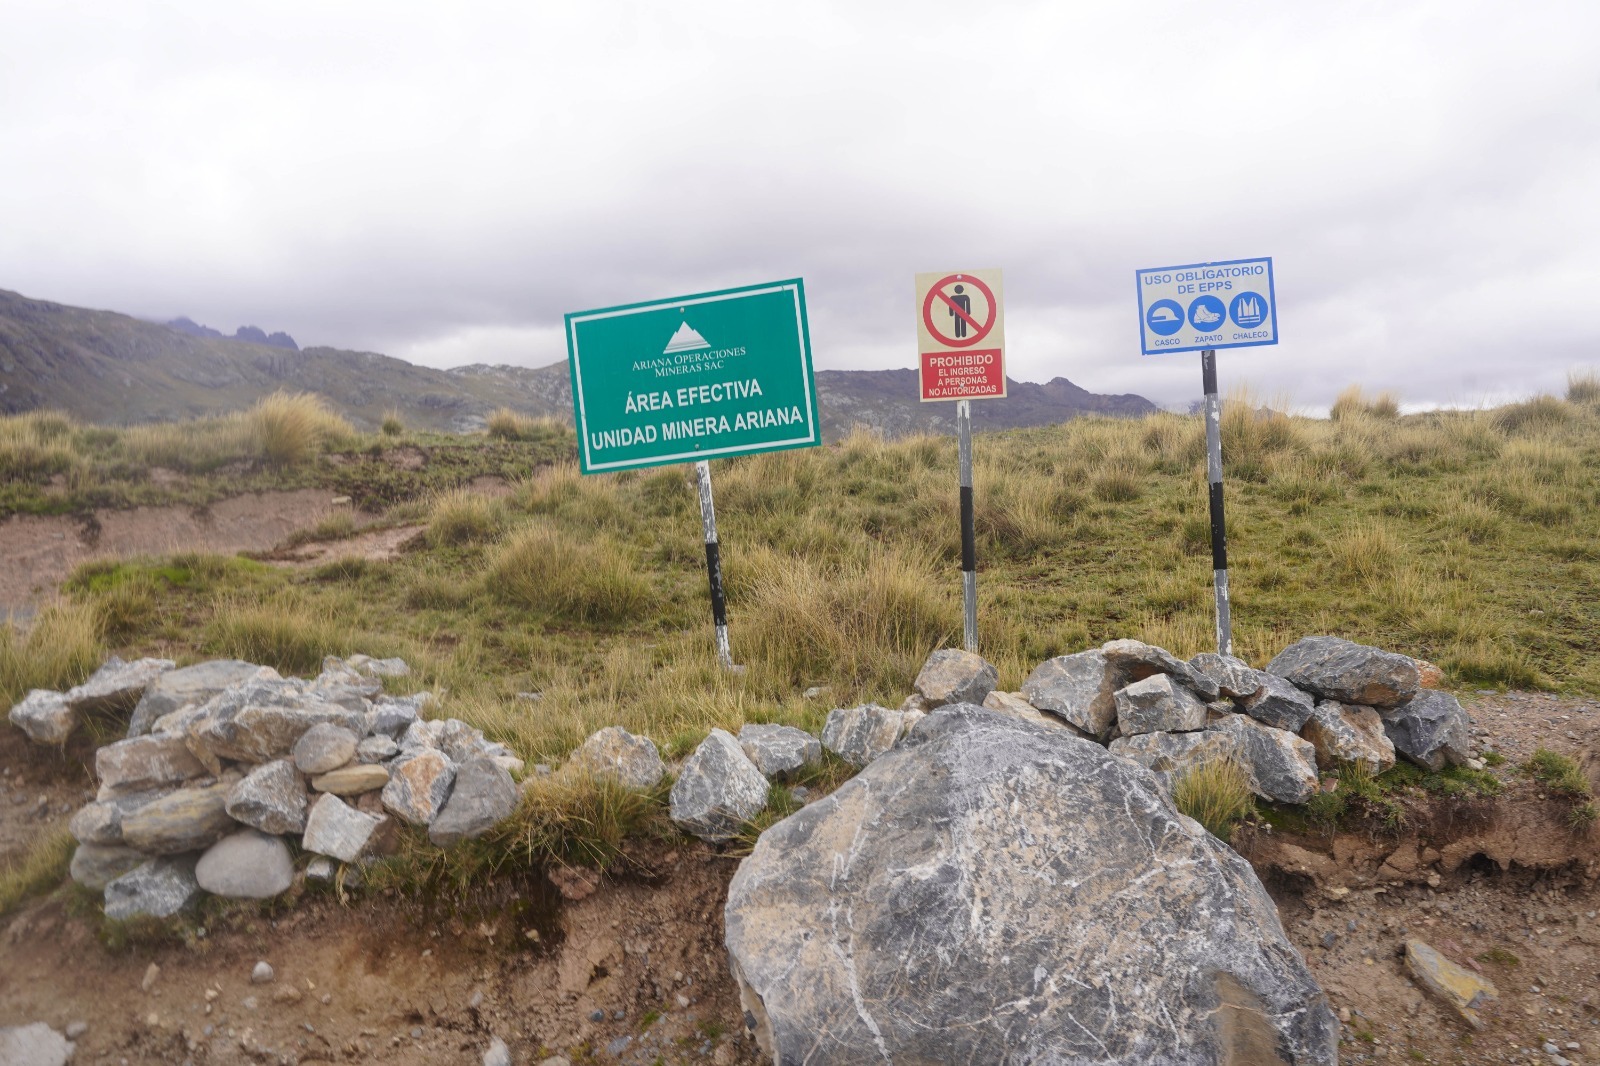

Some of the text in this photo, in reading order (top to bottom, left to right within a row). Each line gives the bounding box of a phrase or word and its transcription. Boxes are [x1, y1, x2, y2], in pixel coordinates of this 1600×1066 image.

[1145, 266, 1264, 285] USO OBLIGATORIO
[1178, 281, 1232, 294] DE EPPS
[1195, 335, 1223, 343] ZAPATO
[1233, 331, 1268, 339] CHALECO
[633, 347, 746, 371] ARIANA OPERACIONES
[930, 354, 993, 367] PROHIBIDO
[655, 360, 724, 377] MINERAS SAC
[950, 367, 985, 375] INGRESO
[945, 376, 987, 385] PERSONAS
[625, 379, 763, 414] ÁREA EFECTIVA
[929, 385, 996, 396] NO AUTORIZADAS
[592, 406, 803, 450] UNIDAD MINERA ARIANA
